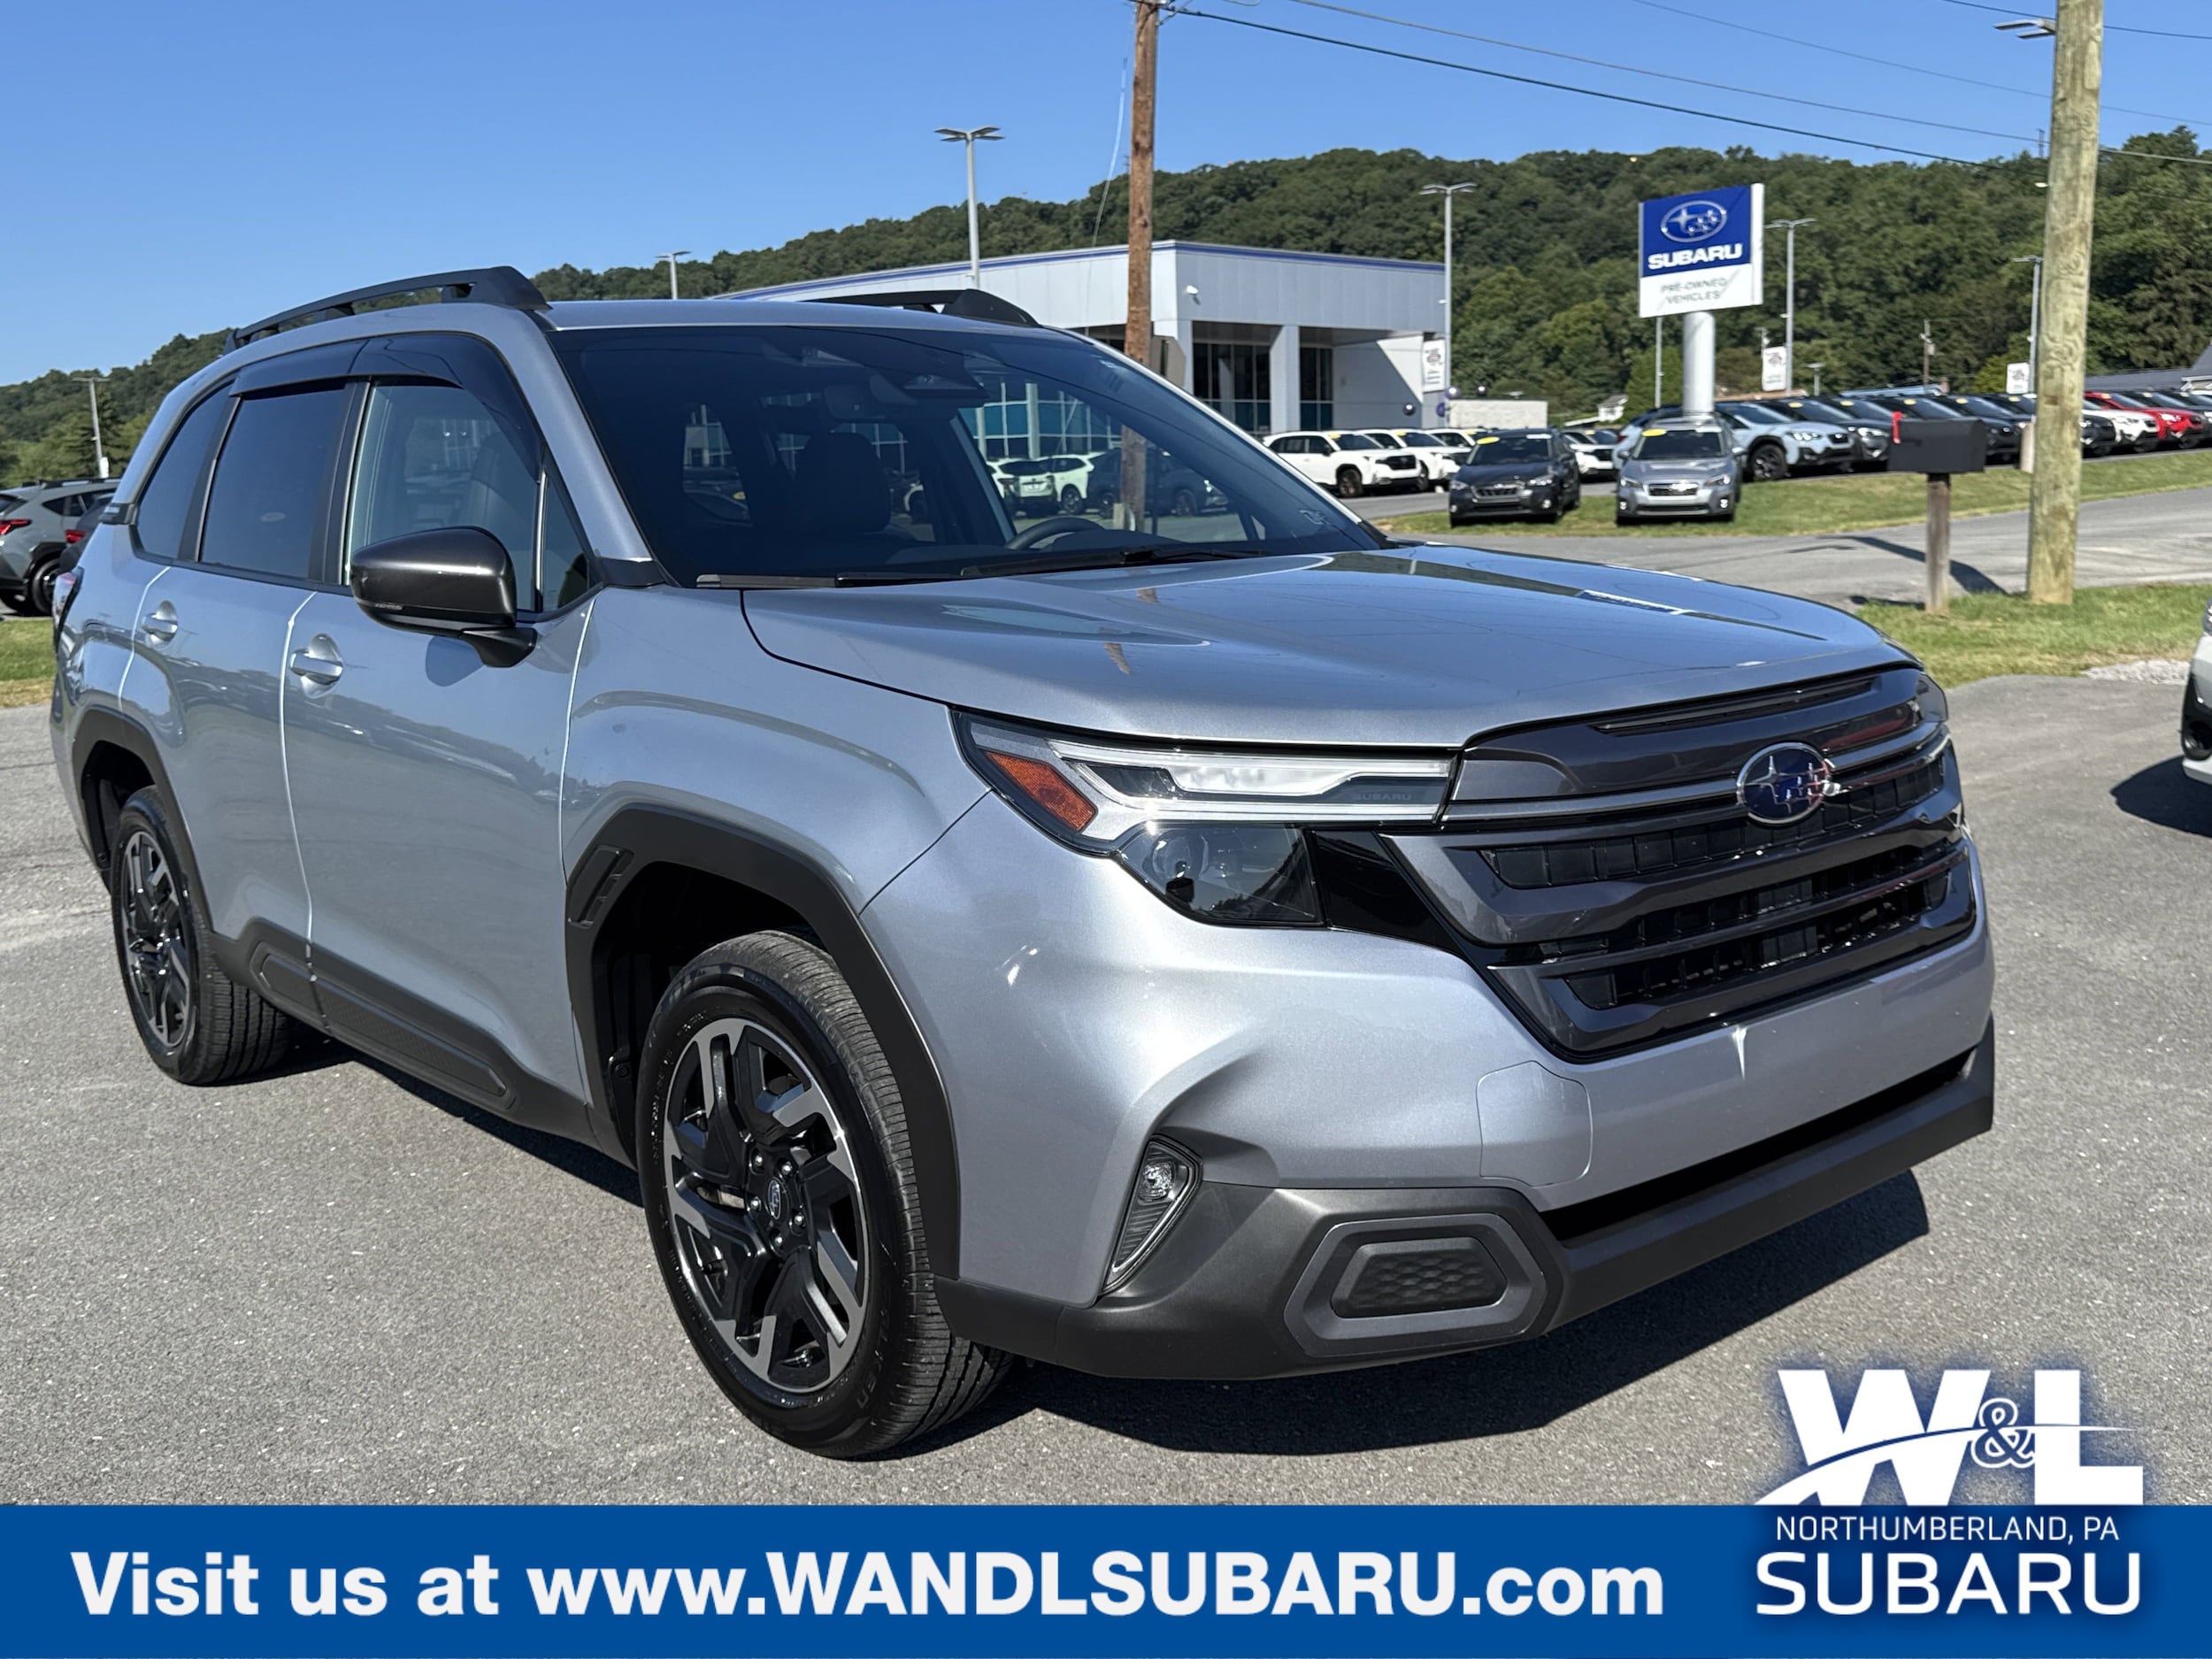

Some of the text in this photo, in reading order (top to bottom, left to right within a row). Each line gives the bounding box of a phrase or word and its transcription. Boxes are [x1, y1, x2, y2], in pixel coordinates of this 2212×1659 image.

[1647, 242, 1743, 270] SUBARU
[1662, 278, 1727, 292] PRE-OWNED
[1666, 291, 1721, 303] VEHICLES
